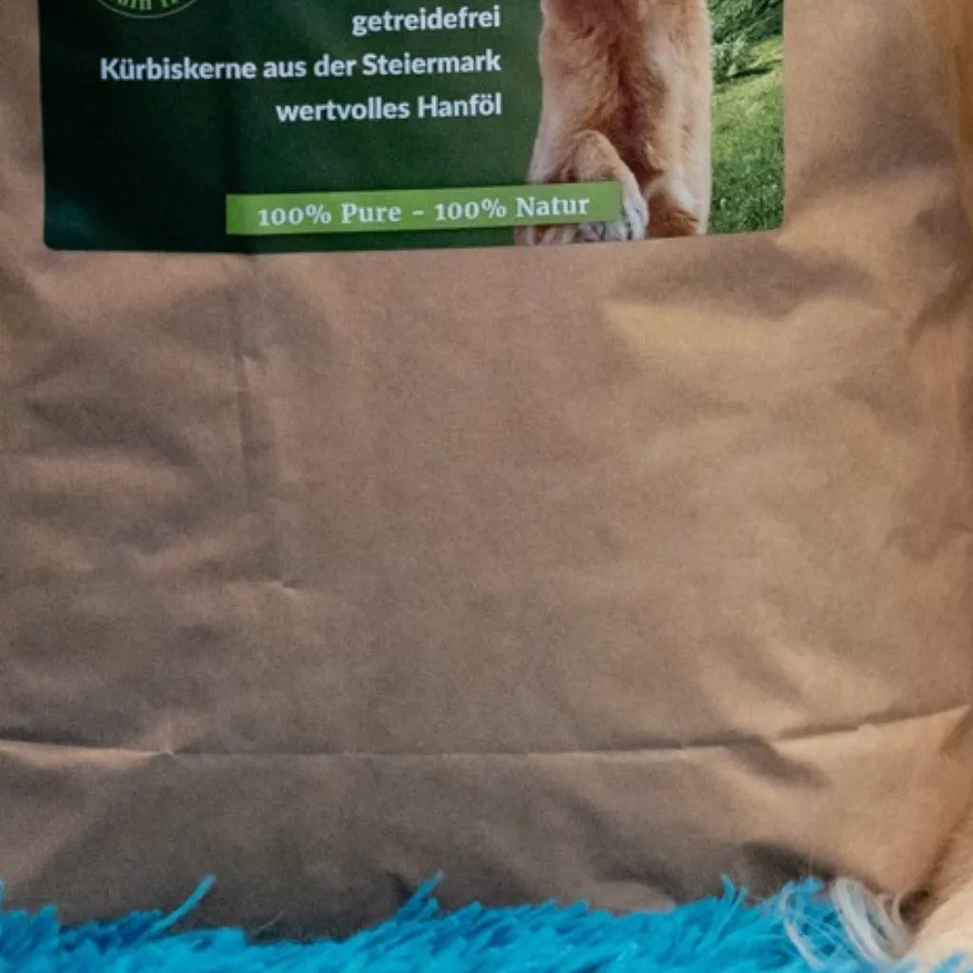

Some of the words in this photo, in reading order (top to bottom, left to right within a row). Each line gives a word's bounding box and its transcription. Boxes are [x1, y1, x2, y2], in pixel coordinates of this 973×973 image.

[352, 4, 501, 37] getreidefrei
[101, 55, 257, 83] Kürbiskerne
[262, 58, 308, 80] aus
[313, 52, 357, 79] der
[362, 48, 502, 75] Steiermark
[276, 96, 410, 123] wertvolles
[417, 92, 502, 120] Hanföl
[258, 201, 332, 228] 100%
[340, 199, 401, 226] Pure
[434, 198, 507, 224] 100%
[515, 192, 590, 220] Natur
